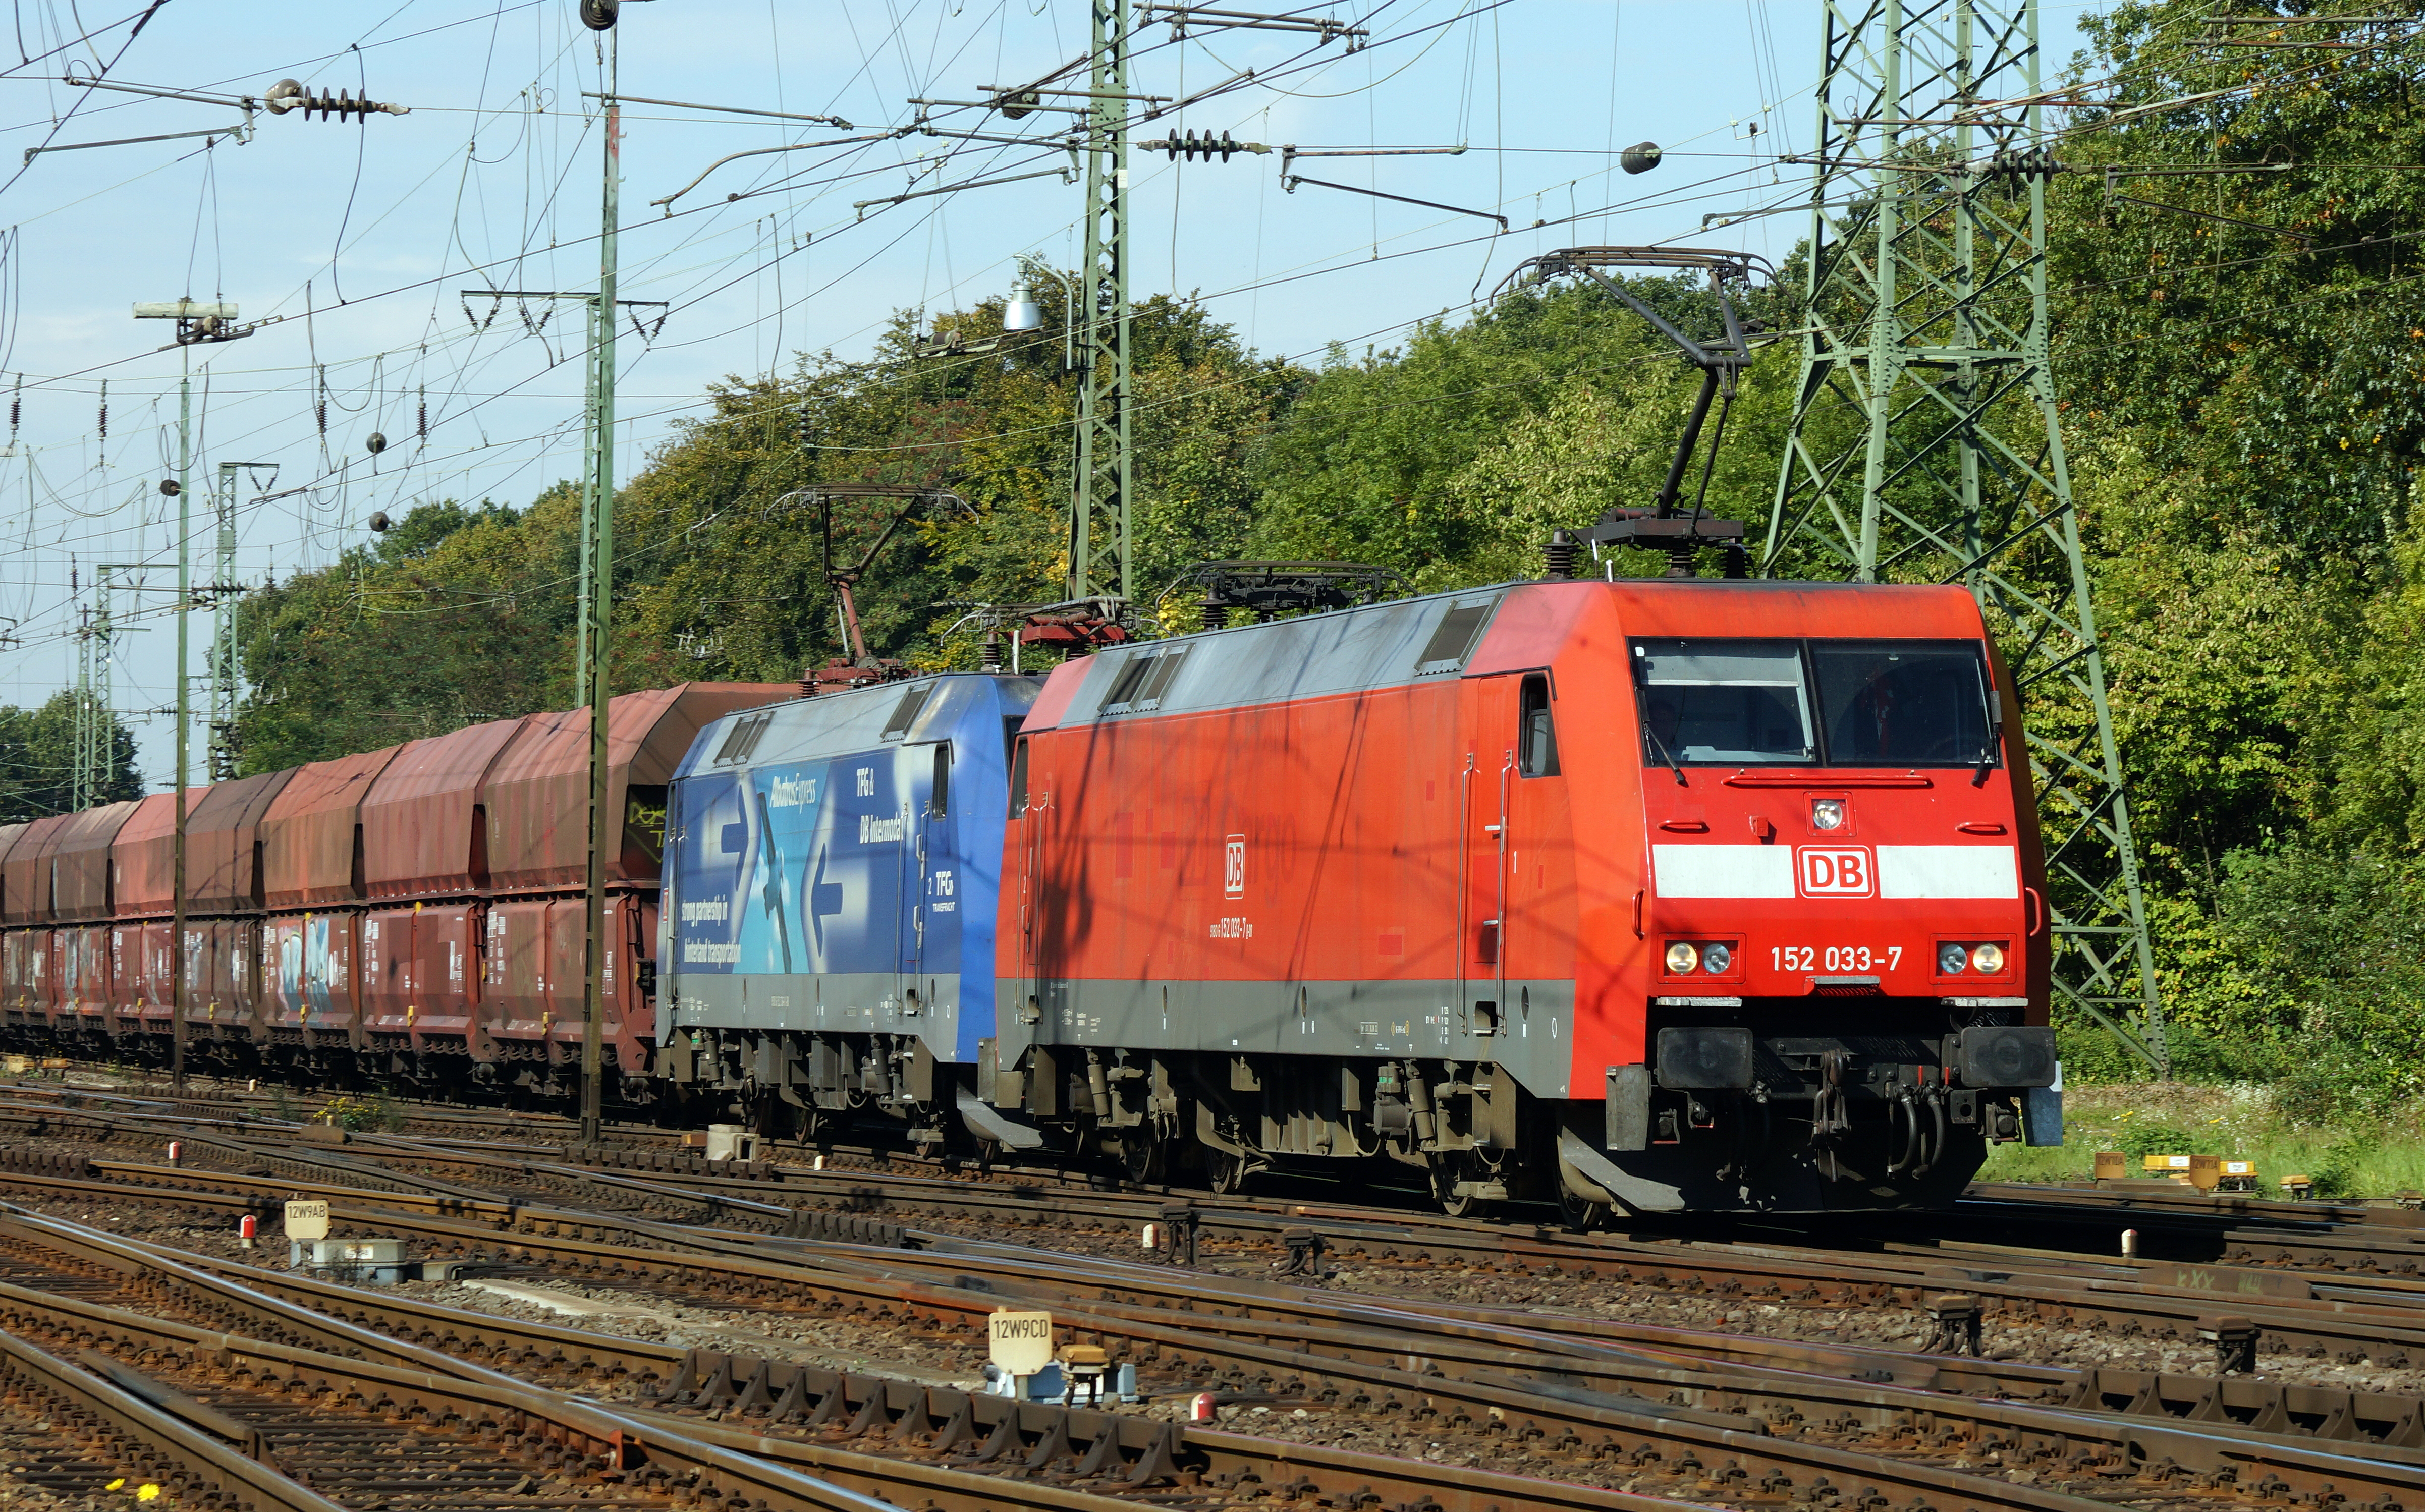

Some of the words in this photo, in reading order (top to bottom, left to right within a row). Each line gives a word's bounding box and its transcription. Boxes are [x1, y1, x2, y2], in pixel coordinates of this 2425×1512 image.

[857, 767, 869, 797] TFG
[869, 768, 874, 796] &
[860, 815, 869, 844] DB
[1808, 853, 1864, 888] DB
[928, 877, 932, 895] 2
[935, 870, 952, 897] TFG
[1022, 875, 1027, 894] 2
[1221, 917, 1230, 938] 152
[1231, 917, 1246, 938] 033-7
[1772, 946, 1815, 972] 152
[1825, 946, 1903, 972] 033-7
[289, 1205, 326, 1219] 12W9AB
[994, 1319, 1048, 1338] 12W9CD
